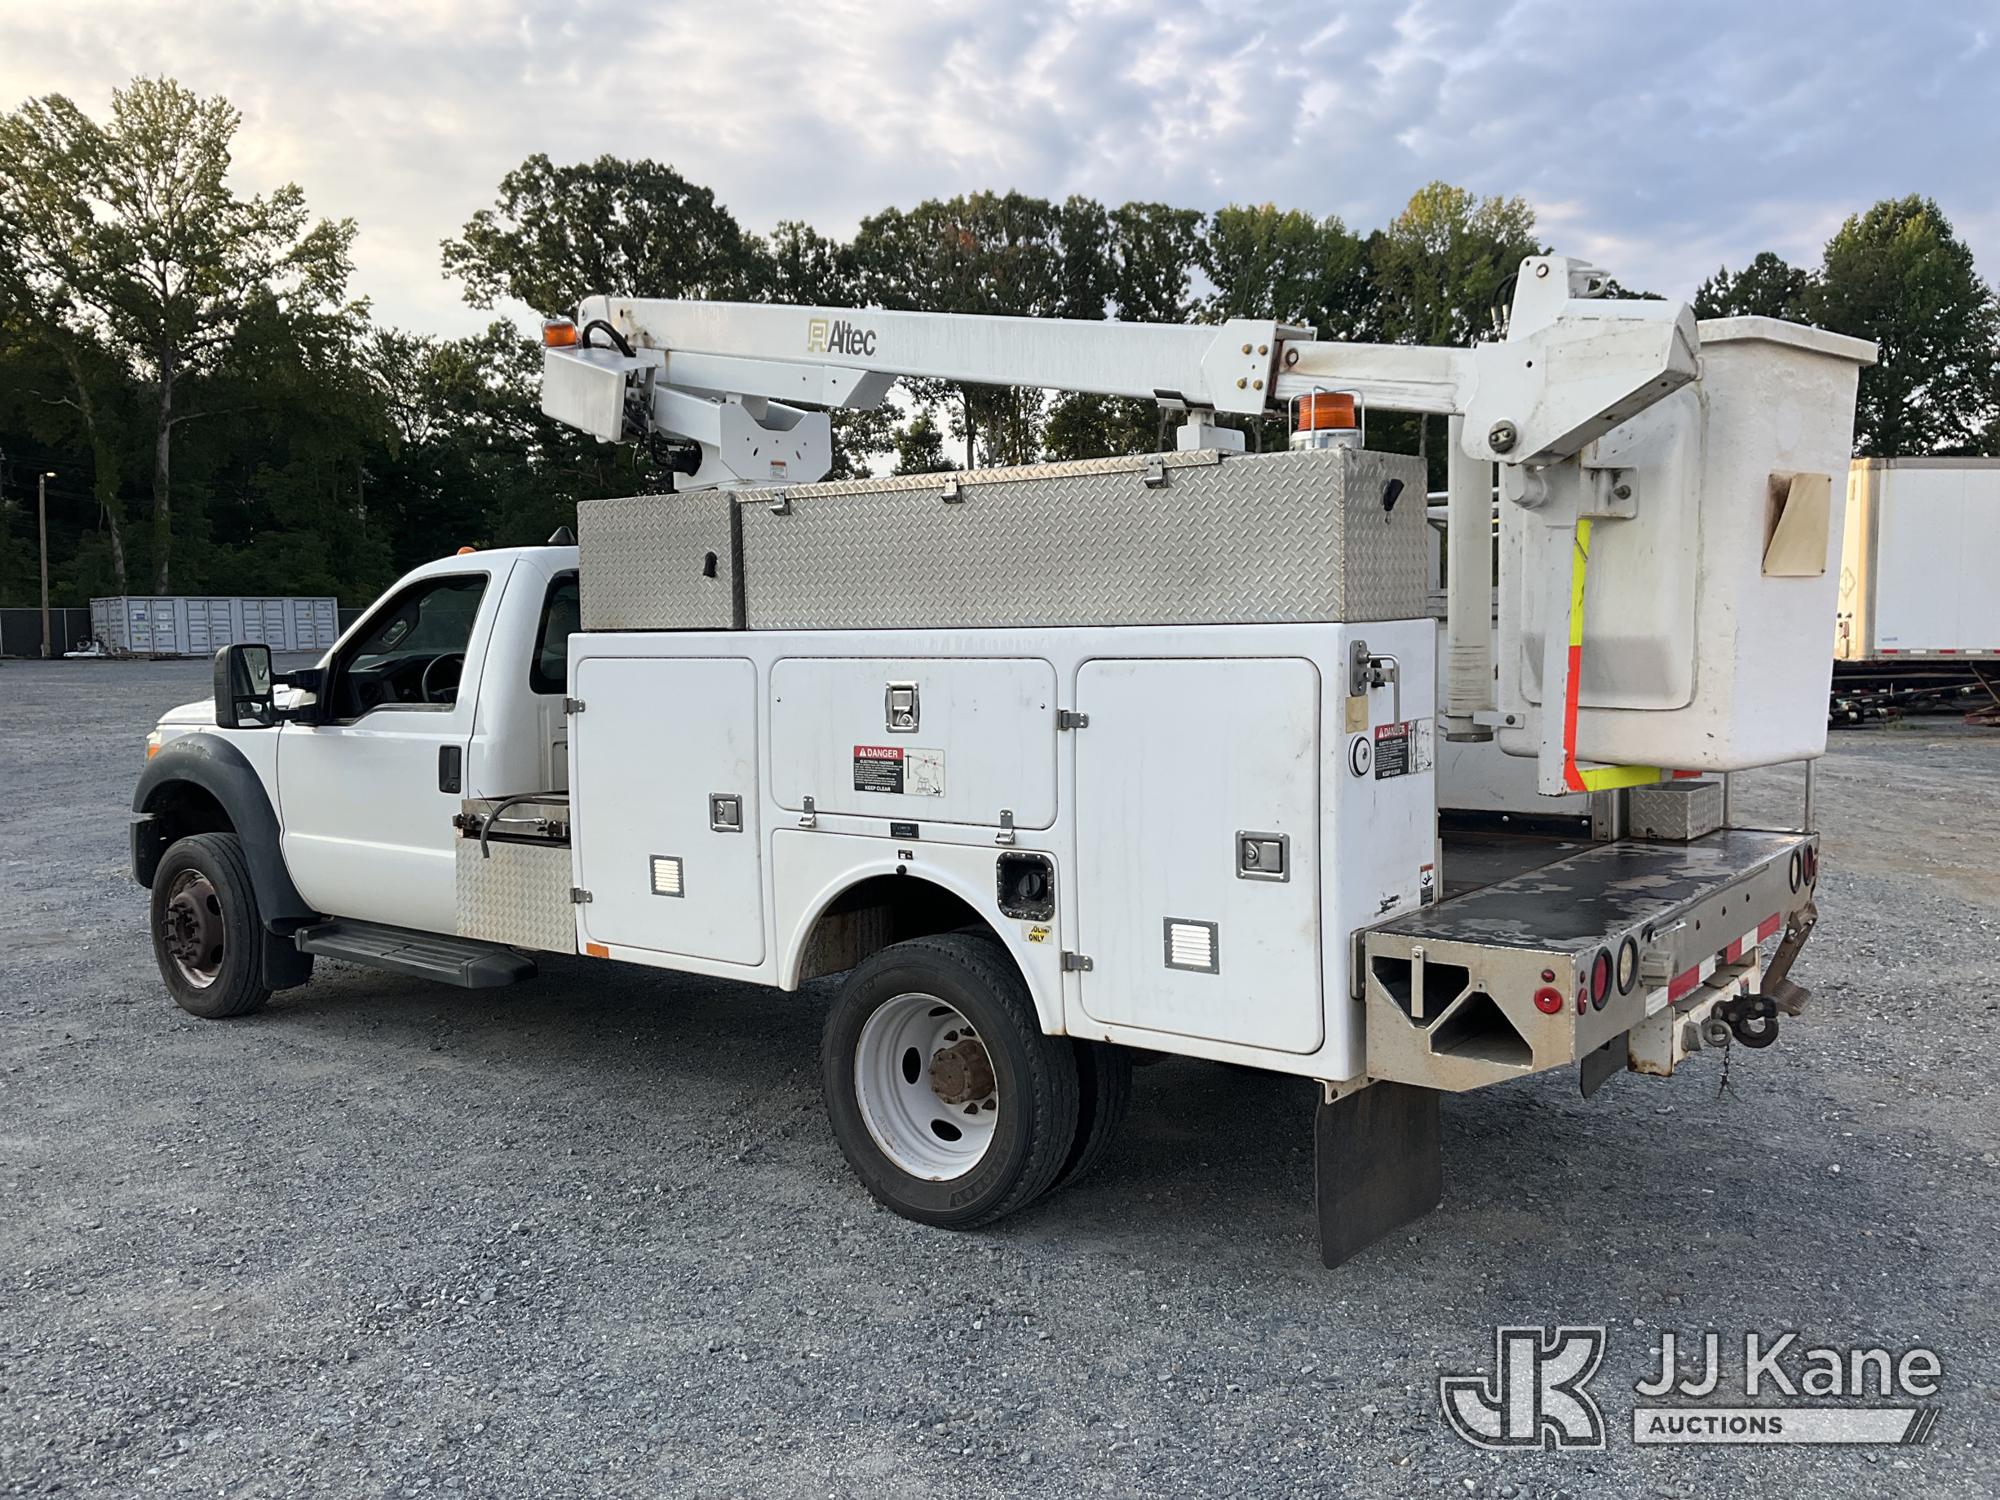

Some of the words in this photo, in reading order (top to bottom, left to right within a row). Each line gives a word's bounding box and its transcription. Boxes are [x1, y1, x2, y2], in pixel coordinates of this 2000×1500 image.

[827, 320, 876, 356] Altec
[867, 748, 898, 758] DANGER
[1028, 933, 1045, 942] ONLY
